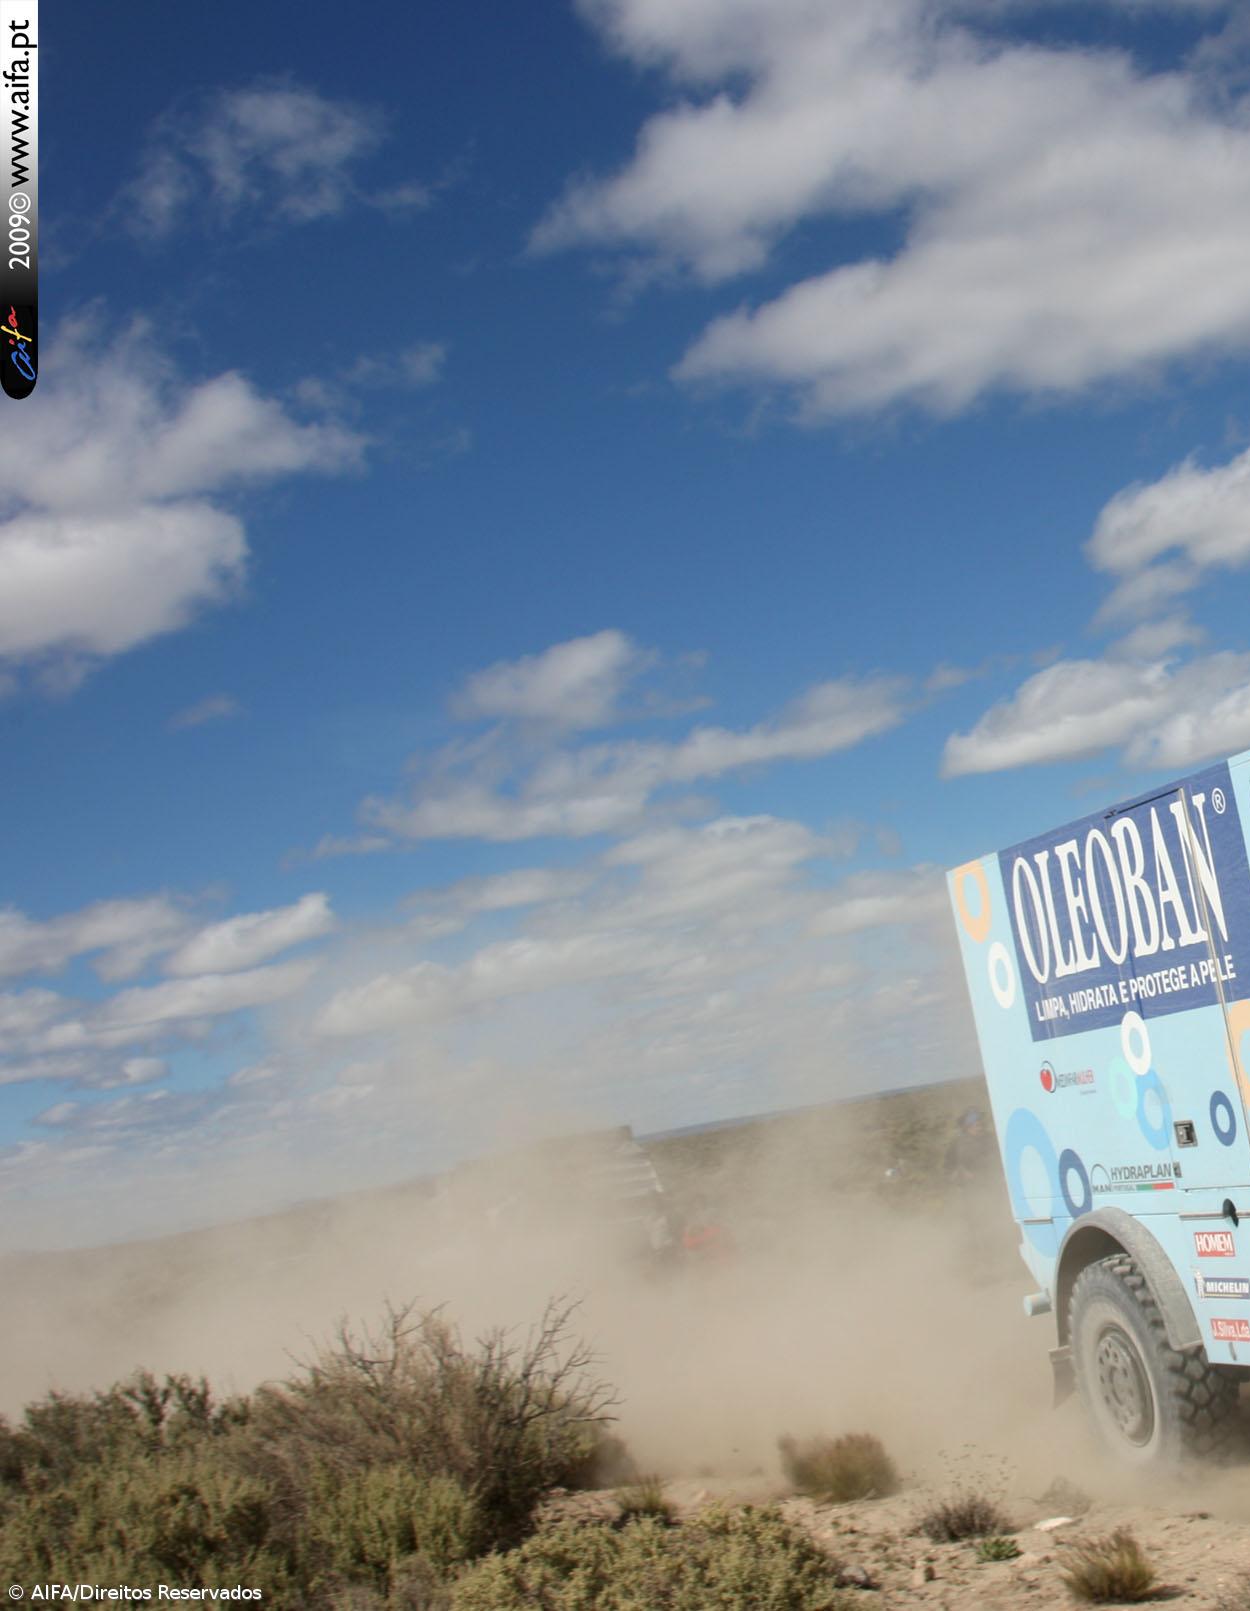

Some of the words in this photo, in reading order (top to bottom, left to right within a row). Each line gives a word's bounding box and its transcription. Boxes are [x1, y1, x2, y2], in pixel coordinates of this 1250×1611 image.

[1036, 996, 1071, 1021] LIMPA,
[1068, 984, 1120, 1016] HIDRATA
[1119, 982, 1130, 1004] E
[1129, 966, 1189, 1001] PROTEGE
[1190, 964, 1201, 987] A
[1199, 955, 1237, 985] PELE
[1111, 1162, 1172, 1181] HYDRAPLAN
[1195, 1233, 1234, 1253] HOMEM
[1206, 1281, 1250, 1293] MICHELIN
